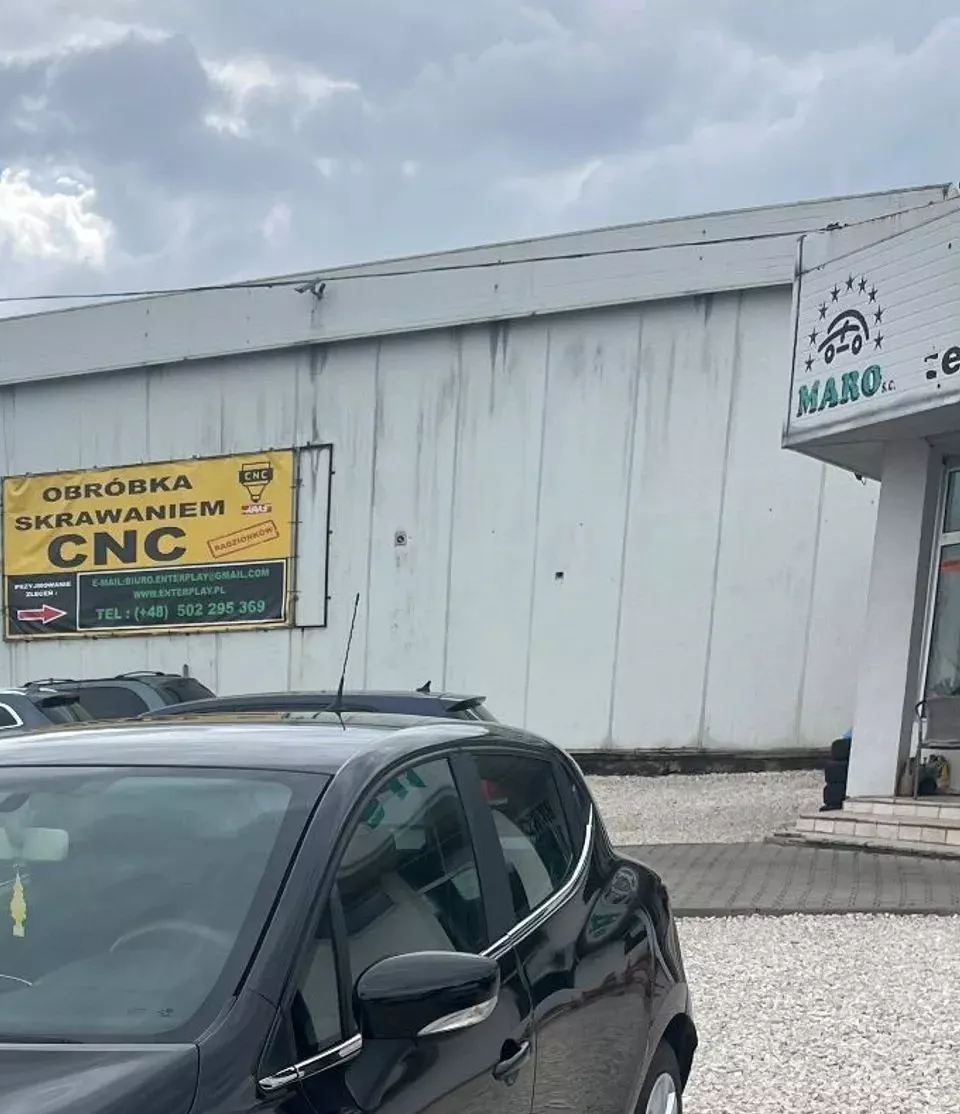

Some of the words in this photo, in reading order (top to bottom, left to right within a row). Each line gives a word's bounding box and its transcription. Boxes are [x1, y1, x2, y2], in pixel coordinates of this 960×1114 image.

[796, 364, 882, 417] MARO
[42, 474, 193, 503] OBRÓBKA
[244, 470, 269, 481] CNC
[14, 500, 225, 531] SKRAWANIEM
[47, 526, 187, 569] CNC
[134, 603, 169, 622] (+48)
[177, 602, 203, 617] 502
[208, 601, 235, 615] 295
[239, 600, 266, 614] 369
